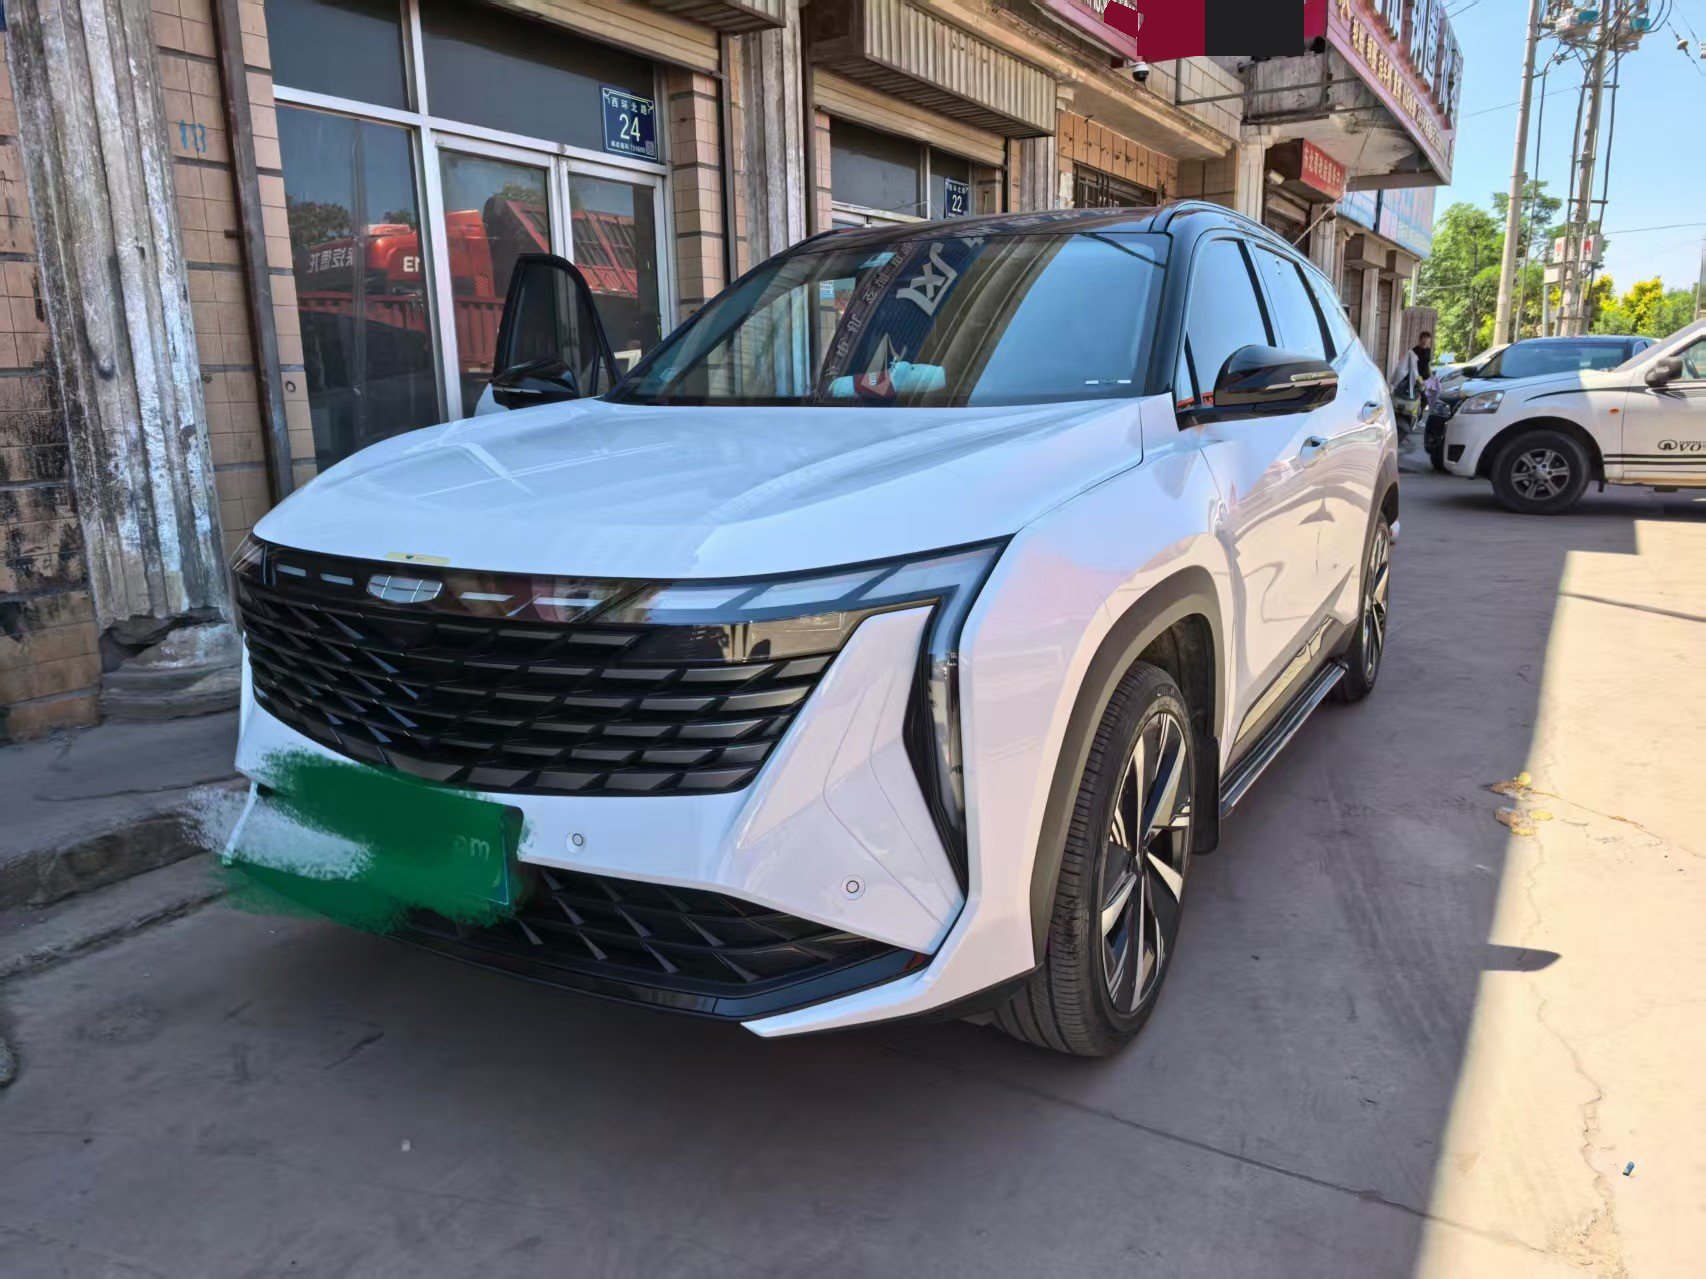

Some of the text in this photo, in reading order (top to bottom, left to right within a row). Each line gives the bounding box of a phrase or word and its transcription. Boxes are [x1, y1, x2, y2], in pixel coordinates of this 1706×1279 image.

[611, 97, 647, 115] 西环北路
[620, 114, 640, 141] 24
[952, 195, 962, 212] 22
